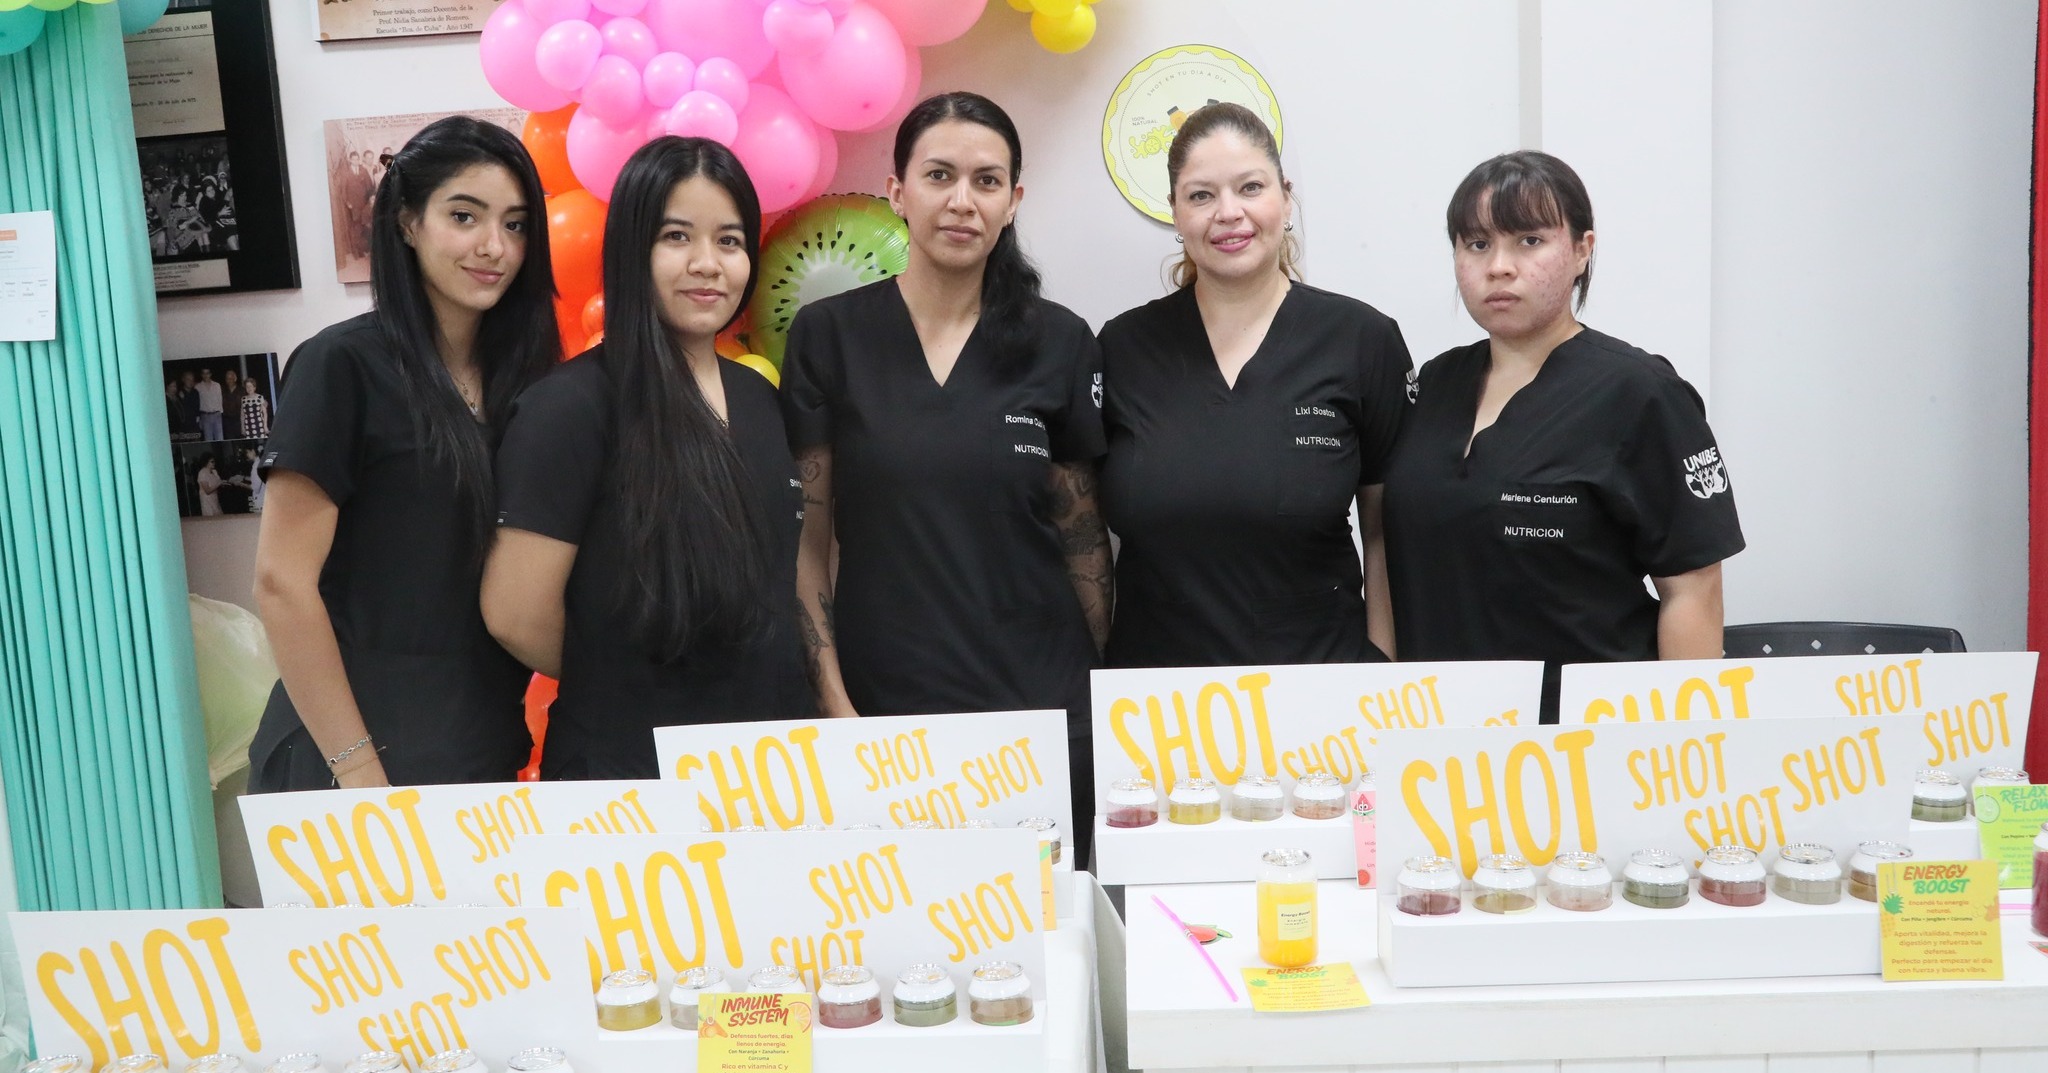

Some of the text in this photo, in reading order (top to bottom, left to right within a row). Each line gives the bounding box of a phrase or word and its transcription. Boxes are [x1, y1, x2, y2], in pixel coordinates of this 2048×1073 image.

[1005, 414, 1034, 425] Romina
[1296, 436, 1341, 447] NUTRICION
[1683, 446, 1719, 473] UNIBE
[1501, 492, 1578, 504] Marlene Centurión
[1504, 525, 1564, 538] NUTRICION
[1358, 675, 1445, 745] SHOT
[1836, 659, 1922, 717] SHOT
[855, 728, 935, 792] SHOT
[1109, 672, 1278, 797] SHOT
[1281, 726, 1368, 785] SHOT
[1923, 693, 2011, 767] SHOT
[676, 725, 835, 831] SHOT
[961, 737, 1043, 809] SHOT
[1400, 729, 1598, 881] SHOT
[1627, 732, 1727, 811] SHOT
[1781, 727, 1888, 813] SHOT
[267, 788, 447, 909] SHOT
[455, 787, 544, 863] SHOT
[1684, 786, 1787, 869] SHOT
[808, 844, 914, 930] SHOT
[1903, 864, 1968, 881] ENERGY
[1913, 878, 1970, 894] BOOST
[927, 872, 1034, 963] SHOT
[36, 916, 262, 1073] SHOT
[288, 923, 404, 1015] SHOT
[434, 917, 552, 1009] SHOT
[1266, 965, 1325, 976] ENERGY
[358, 992, 469, 1073] SHOT
[720, 993, 783, 1013] INMUNE
[727, 1007, 789, 1028] SYSTEM
